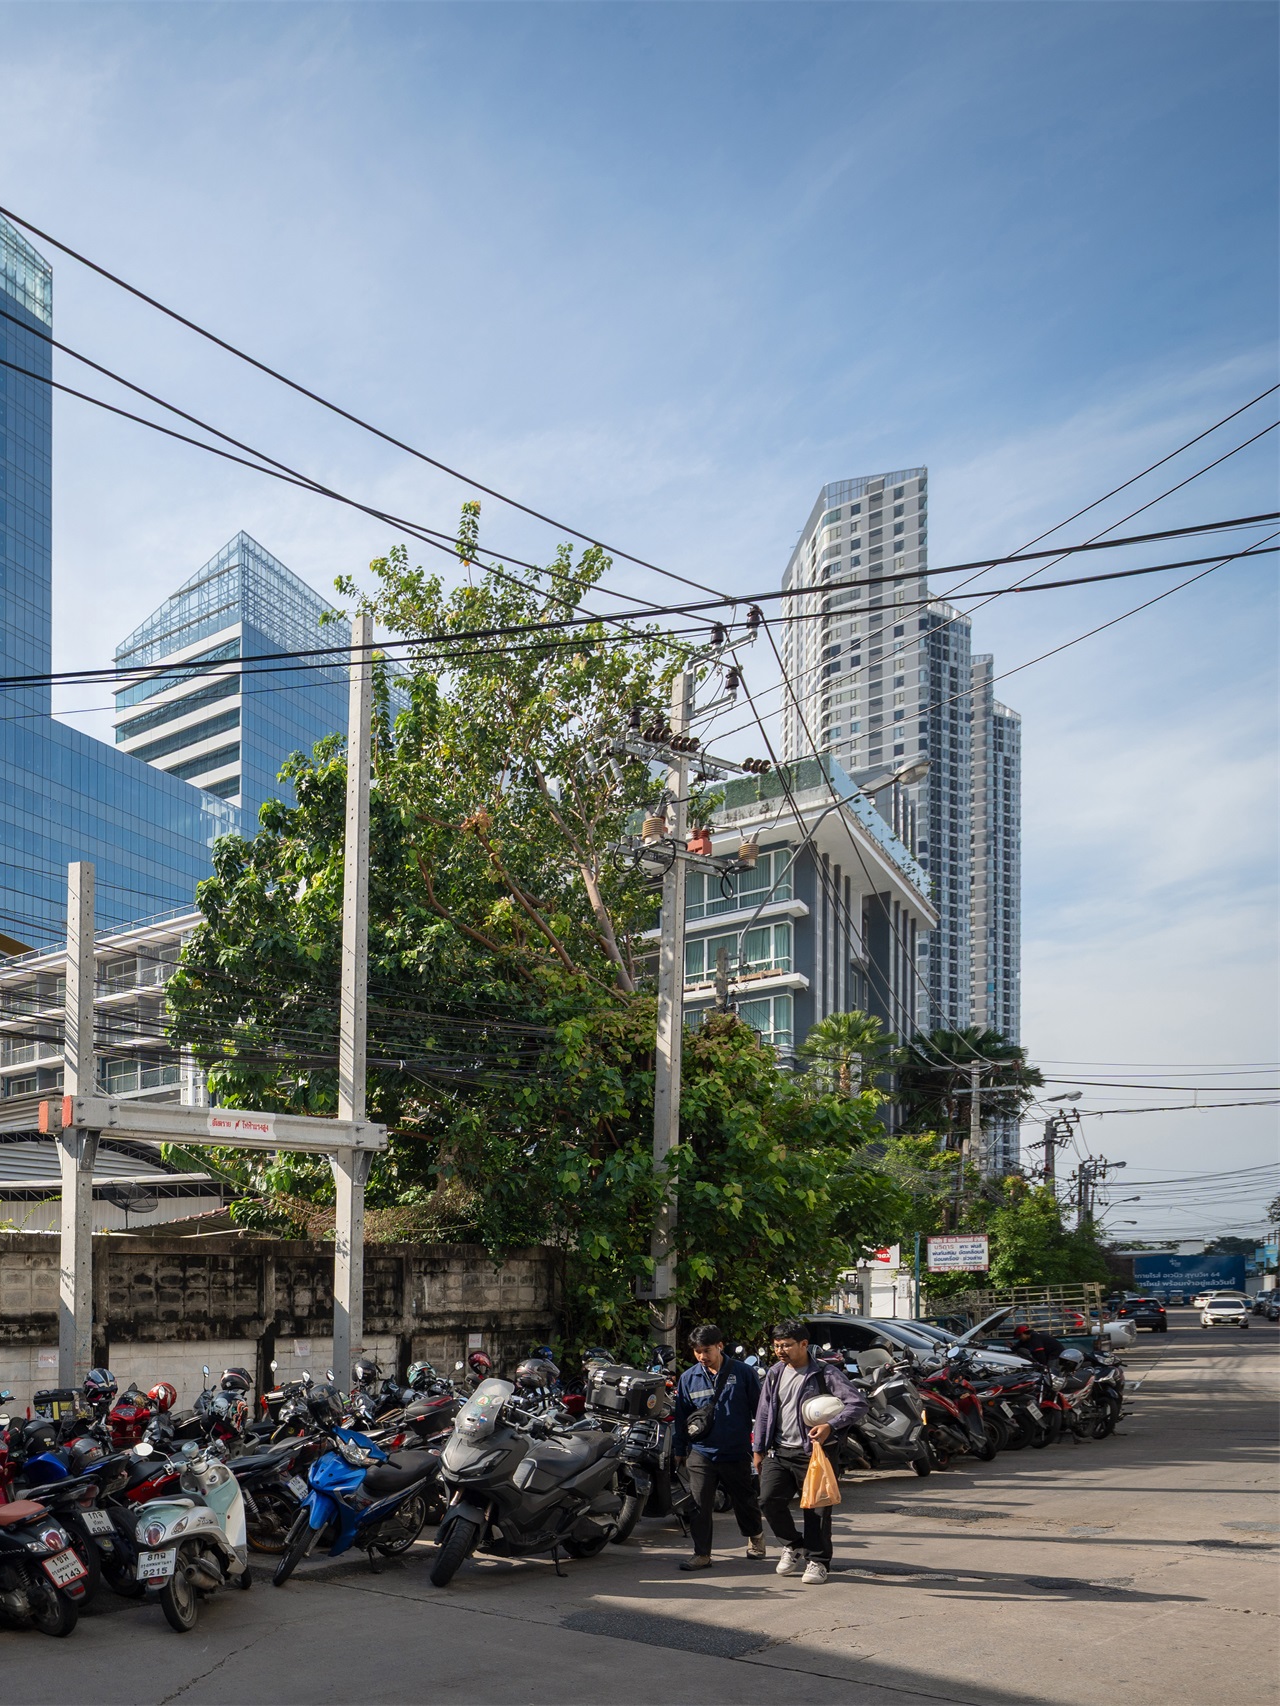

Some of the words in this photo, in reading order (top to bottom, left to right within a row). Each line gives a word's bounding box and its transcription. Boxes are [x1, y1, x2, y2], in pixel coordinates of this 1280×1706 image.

[212, 1118, 232, 1128] อันตราย
[92, 1526, 112, 1534] 6938
[52, 1560, 78, 1576] กรุงเทพมหานคร
[140, 1560, 172, 1569] กรุงเทพมหานคร
[58, 1568, 81, 1583] 7143
[143, 1566, 168, 1577] 9215
